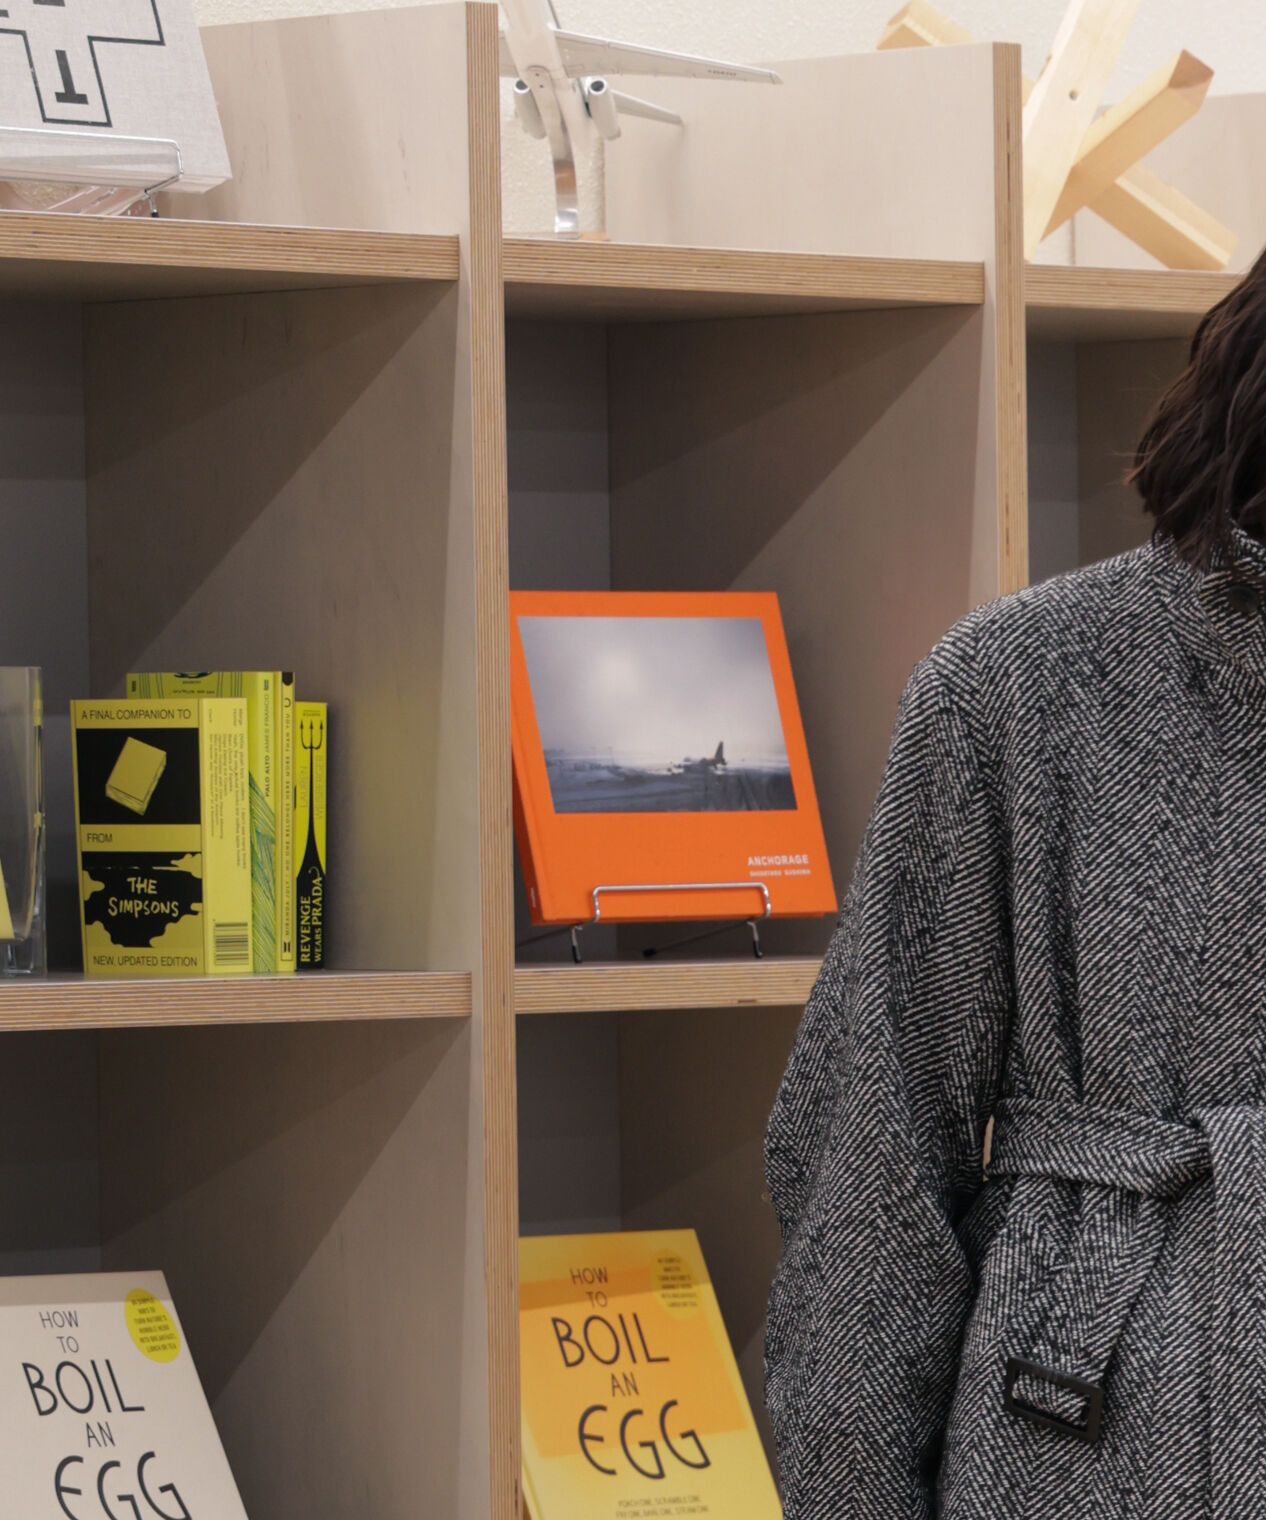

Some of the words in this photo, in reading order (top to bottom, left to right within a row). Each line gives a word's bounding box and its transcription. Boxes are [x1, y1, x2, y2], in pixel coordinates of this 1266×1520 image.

[81, 710, 88, 720] A
[89, 709, 115, 720] FINAL
[114, 709, 175, 720] COMPANION
[177, 709, 191, 720] TO
[86, 832, 113, 843] FROM
[747, 854, 809, 866] ANCHORAGE
[126, 876, 158, 895] THE
[107, 896, 179, 918] SIMPSONS
[300, 895, 311, 962] REVENGE
[314, 927, 322, 962] WEARS
[93, 955, 116, 967] NEW,
[117, 956, 159, 967] UPDATED
[160, 956, 197, 967] EDITION
[569, 1267, 609, 1285] HOW
[585, 1290, 608, 1308] TO
[39, 1310, 80, 1329] HOW
[56, 1336, 80, 1354] TO
[551, 1312, 670, 1368] BOIL
[21, 1358, 146, 1416] BOIL
[610, 1371, 640, 1398] AN
[86, 1421, 116, 1448] AN
[578, 1399, 712, 1480] EGG
